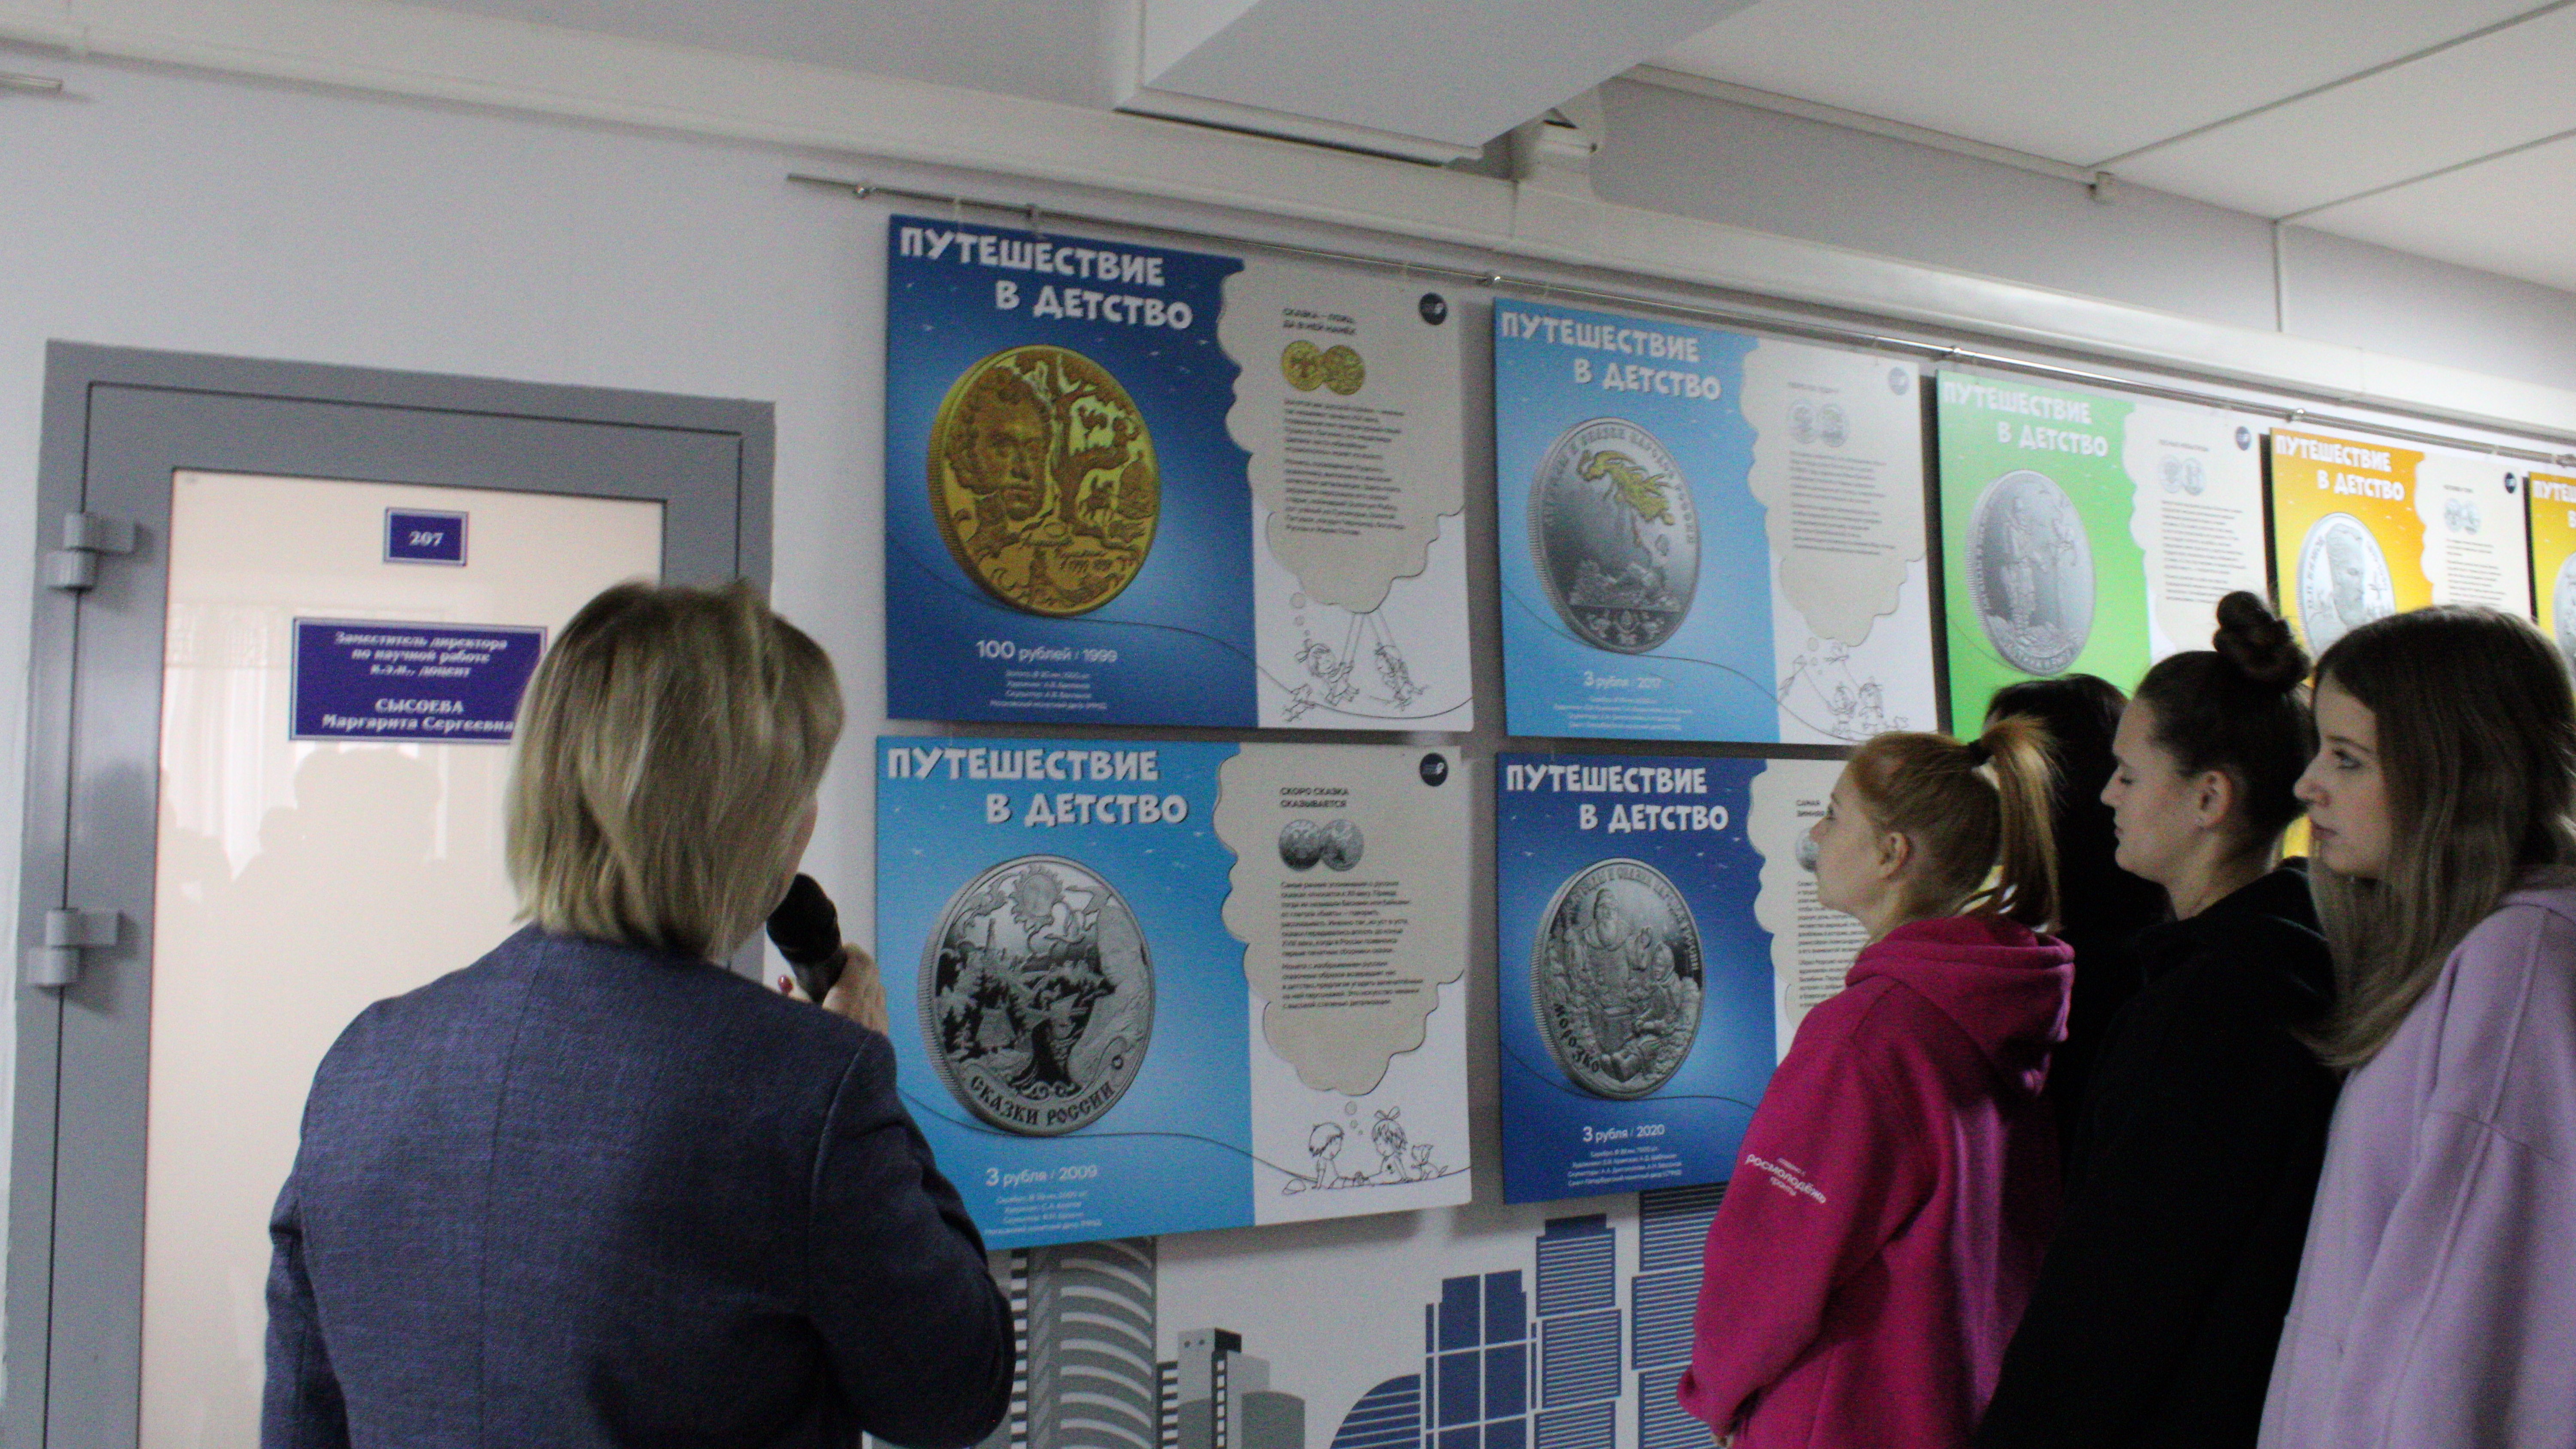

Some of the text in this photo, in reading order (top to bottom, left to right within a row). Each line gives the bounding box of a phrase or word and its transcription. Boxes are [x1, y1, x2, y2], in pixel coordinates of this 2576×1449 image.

[901, 227, 1165, 286] ПУТЕШЕСТВИЕ
[995, 280, 1193, 330] В ДЕТСТВО
[1502, 311, 1700, 362] ПУТЕШЕСТВИЕ
[1574, 358, 1722, 400] В ДЕТСТВО
[1943, 381, 2092, 424] ПУТЕШЕСТВИЕ
[1998, 421, 2108, 457] В ДЕТСТВО
[2275, 435, 2392, 472] ПУТЕШЕСТВИЕ
[2317, 469, 2405, 501] В ДЕТСТВО
[409, 531, 444, 547] 207
[335, 631, 508, 652] Заместитель директора
[976, 640, 1016, 659] 100
[1019, 647, 1072, 662] рублей
[1083, 649, 1117, 663] 1999
[352, 649, 491, 664] по научной работе
[418, 666, 471, 677] доцент
[1583, 671, 1594, 687] 3
[1596, 675, 1629, 689] рубля
[375, 698, 464, 714] СЫСОЕВА
[322, 714, 418, 732] Маргарита
[888, 746, 1159, 781] ПУТЕШЕСТВИЕ
[1280, 787, 1349, 796] СКОРО СКАЗКА
[1506, 764, 1707, 793] ПУТЕШЕСТВИЕ
[987, 793, 1189, 827] В ДЕТСТВО
[1280, 799, 1347, 808] СКАЗЫВАЕТСЯ
[1579, 804, 1729, 833] В ДЕТСТВО
[1553, 1003, 1600, 1072] МОРОЗКО
[970, 1075, 1116, 1127] СКАЗКИ РОССИИ
[1582, 1126, 1593, 1142] 3
[1595, 1128, 1628, 1143] рубля
[1636, 1124, 1665, 1138] 2020
[985, 1167, 999, 1187] 3
[1003, 1170, 1047, 1189] рубля
[1058, 1164, 1098, 1181] 2009
[1745, 1154, 1826, 1204] росмолодёжь
